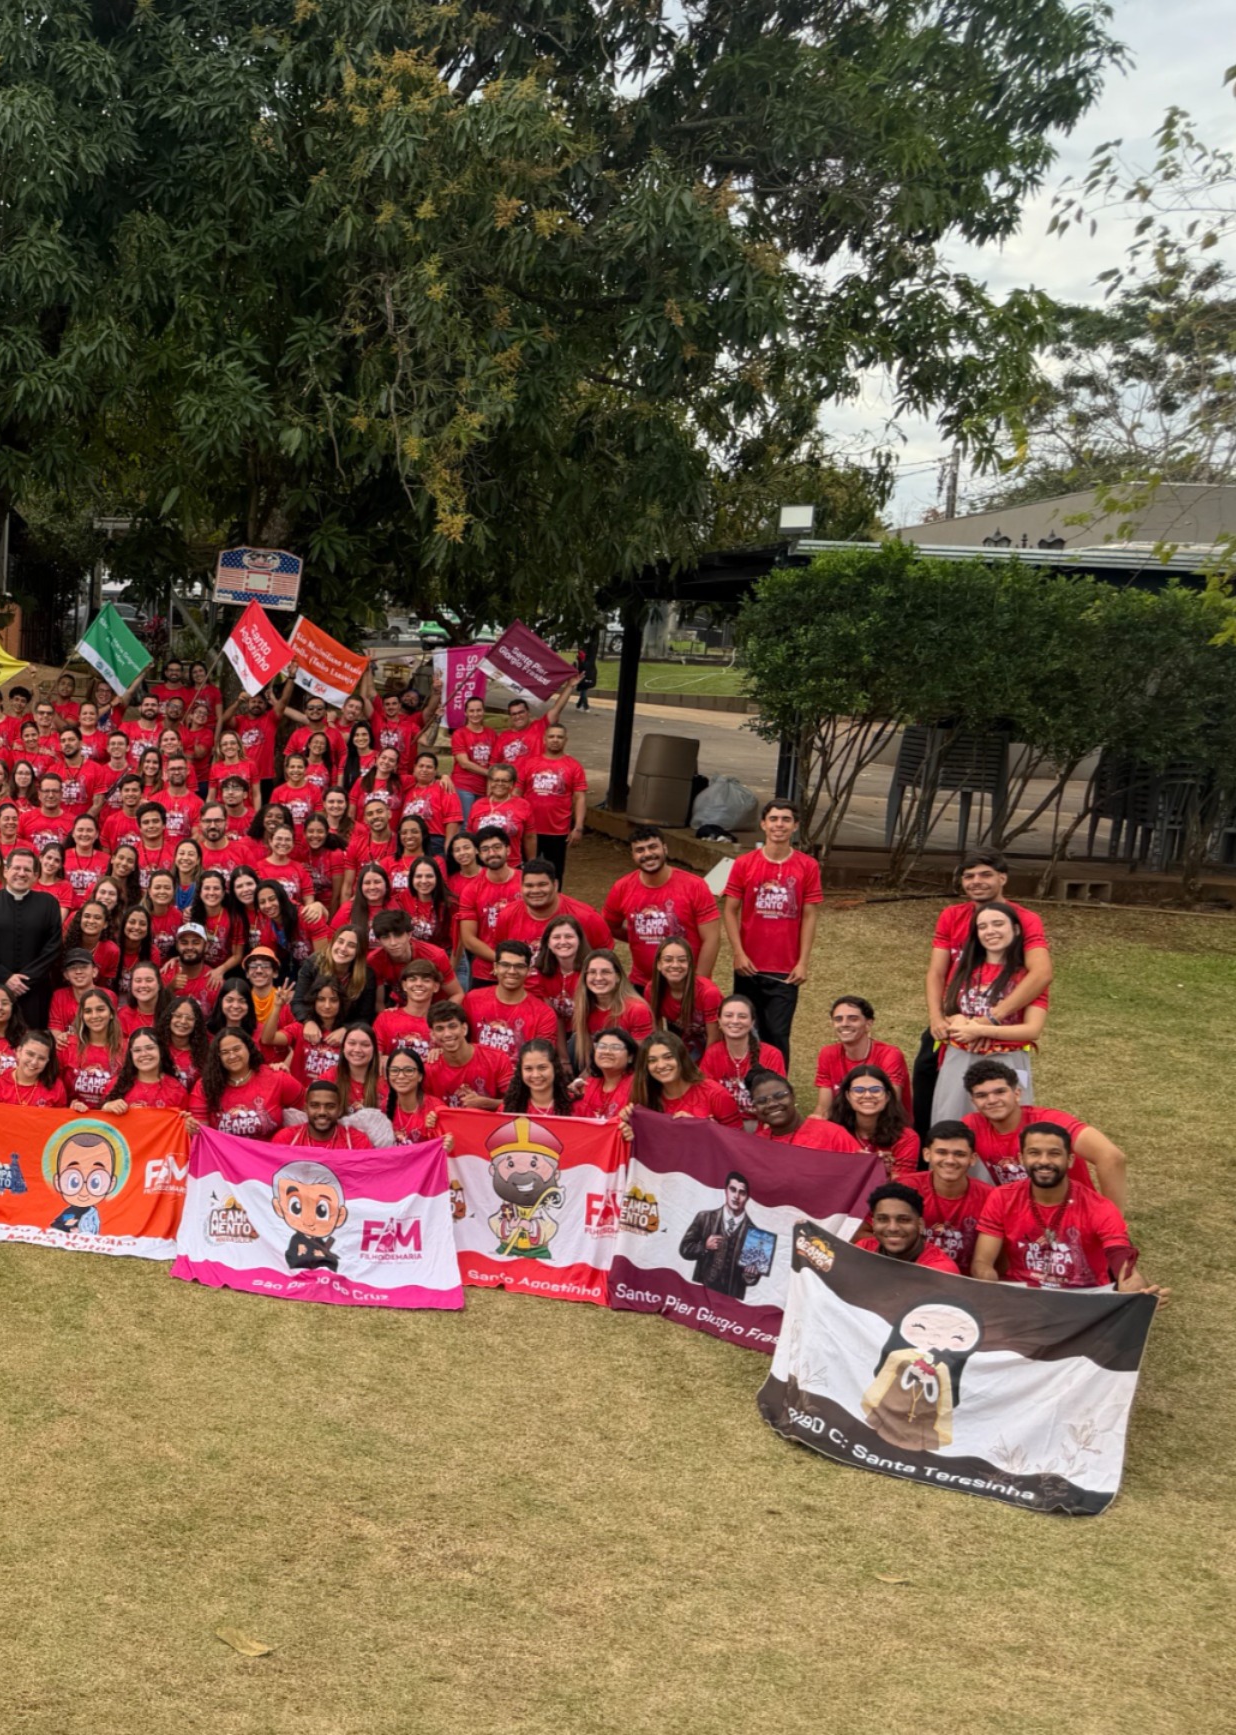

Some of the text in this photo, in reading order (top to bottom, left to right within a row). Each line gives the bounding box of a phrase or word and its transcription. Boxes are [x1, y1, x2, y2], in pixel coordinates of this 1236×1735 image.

[251, 624, 271, 655] Santo
[634, 919, 668, 927] ACAMPA
[634, 926, 664, 935] MENTO
[480, 1030, 514, 1044] ACAMPA
[307, 1055, 339, 1066] ACAMP
[75, 1075, 110, 1086] ACAMP
[218, 1117, 261, 1129] ACAMPA
[621, 1197, 659, 1218] CAMPA
[620, 1212, 649, 1228] ENTO
[210, 1222, 252, 1236] MENTO
[1028, 1243, 1039, 1251] 10
[517, 1276, 602, 1298] Agostinho
[615, 1283, 661, 1304] Santo
[663, 1294, 697, 1317] Pier
[745, 1327, 780, 1345] Fras
[828, 1428, 850, 1450] C:
[852, 1444, 916, 1474] Santa
[922, 1466, 1036, 1501] Teresinha
